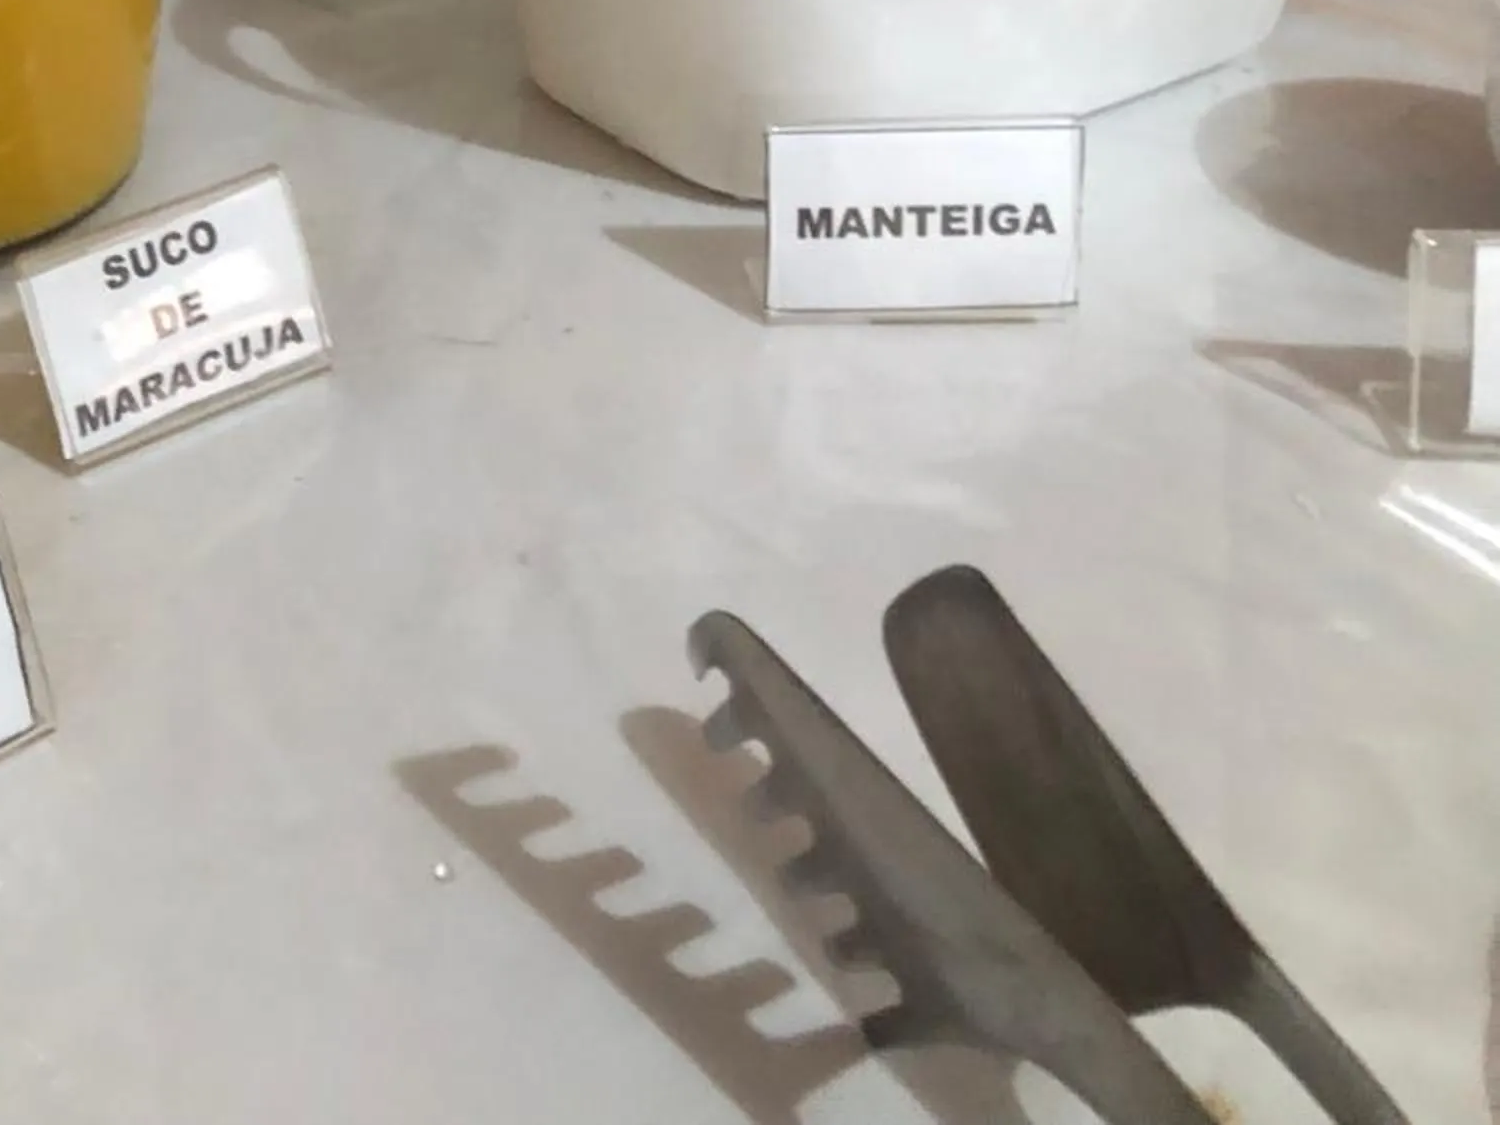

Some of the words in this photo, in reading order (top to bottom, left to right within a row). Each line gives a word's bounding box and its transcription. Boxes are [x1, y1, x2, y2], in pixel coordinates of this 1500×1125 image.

[796, 202, 1056, 240] MANTEIGA
[102, 220, 218, 290] SUCO
[150, 290, 209, 339] DE
[75, 315, 304, 437] MARACUJA
